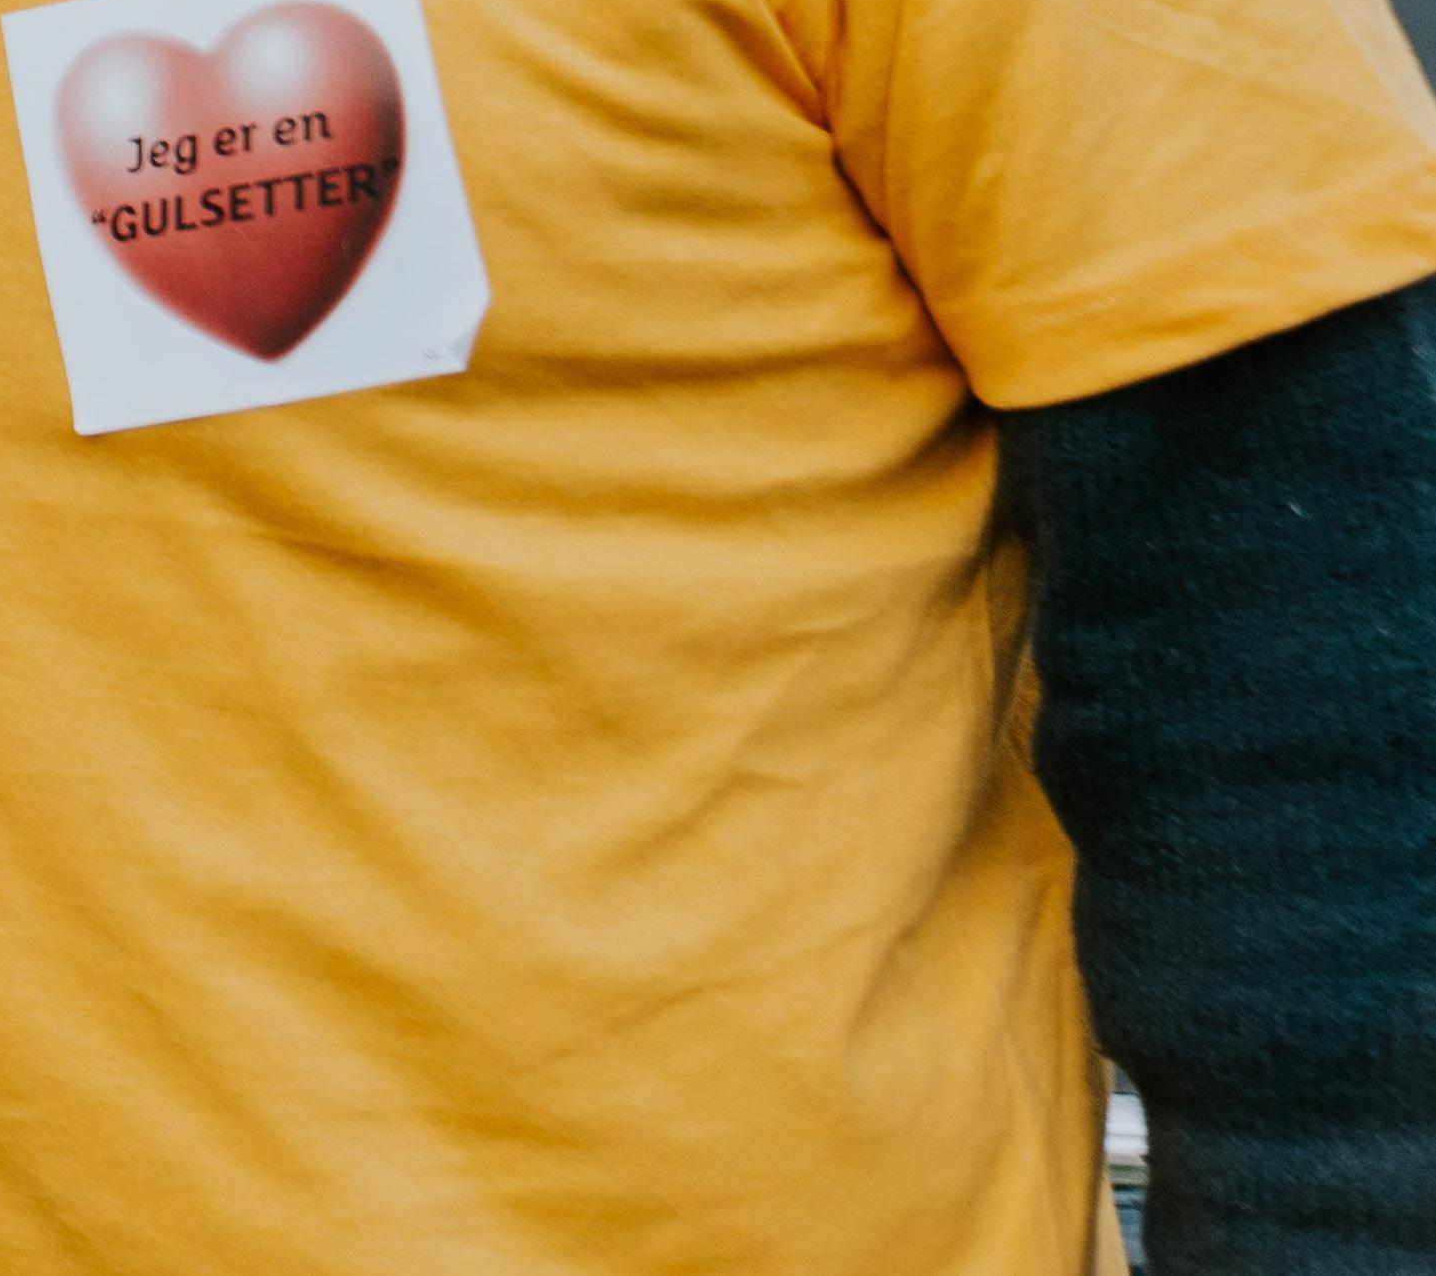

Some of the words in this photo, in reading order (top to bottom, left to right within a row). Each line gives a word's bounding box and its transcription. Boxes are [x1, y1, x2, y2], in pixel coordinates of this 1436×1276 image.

[126, 133, 198, 174] Jeg
[213, 120, 258, 156] er
[272, 109, 332, 146] en
